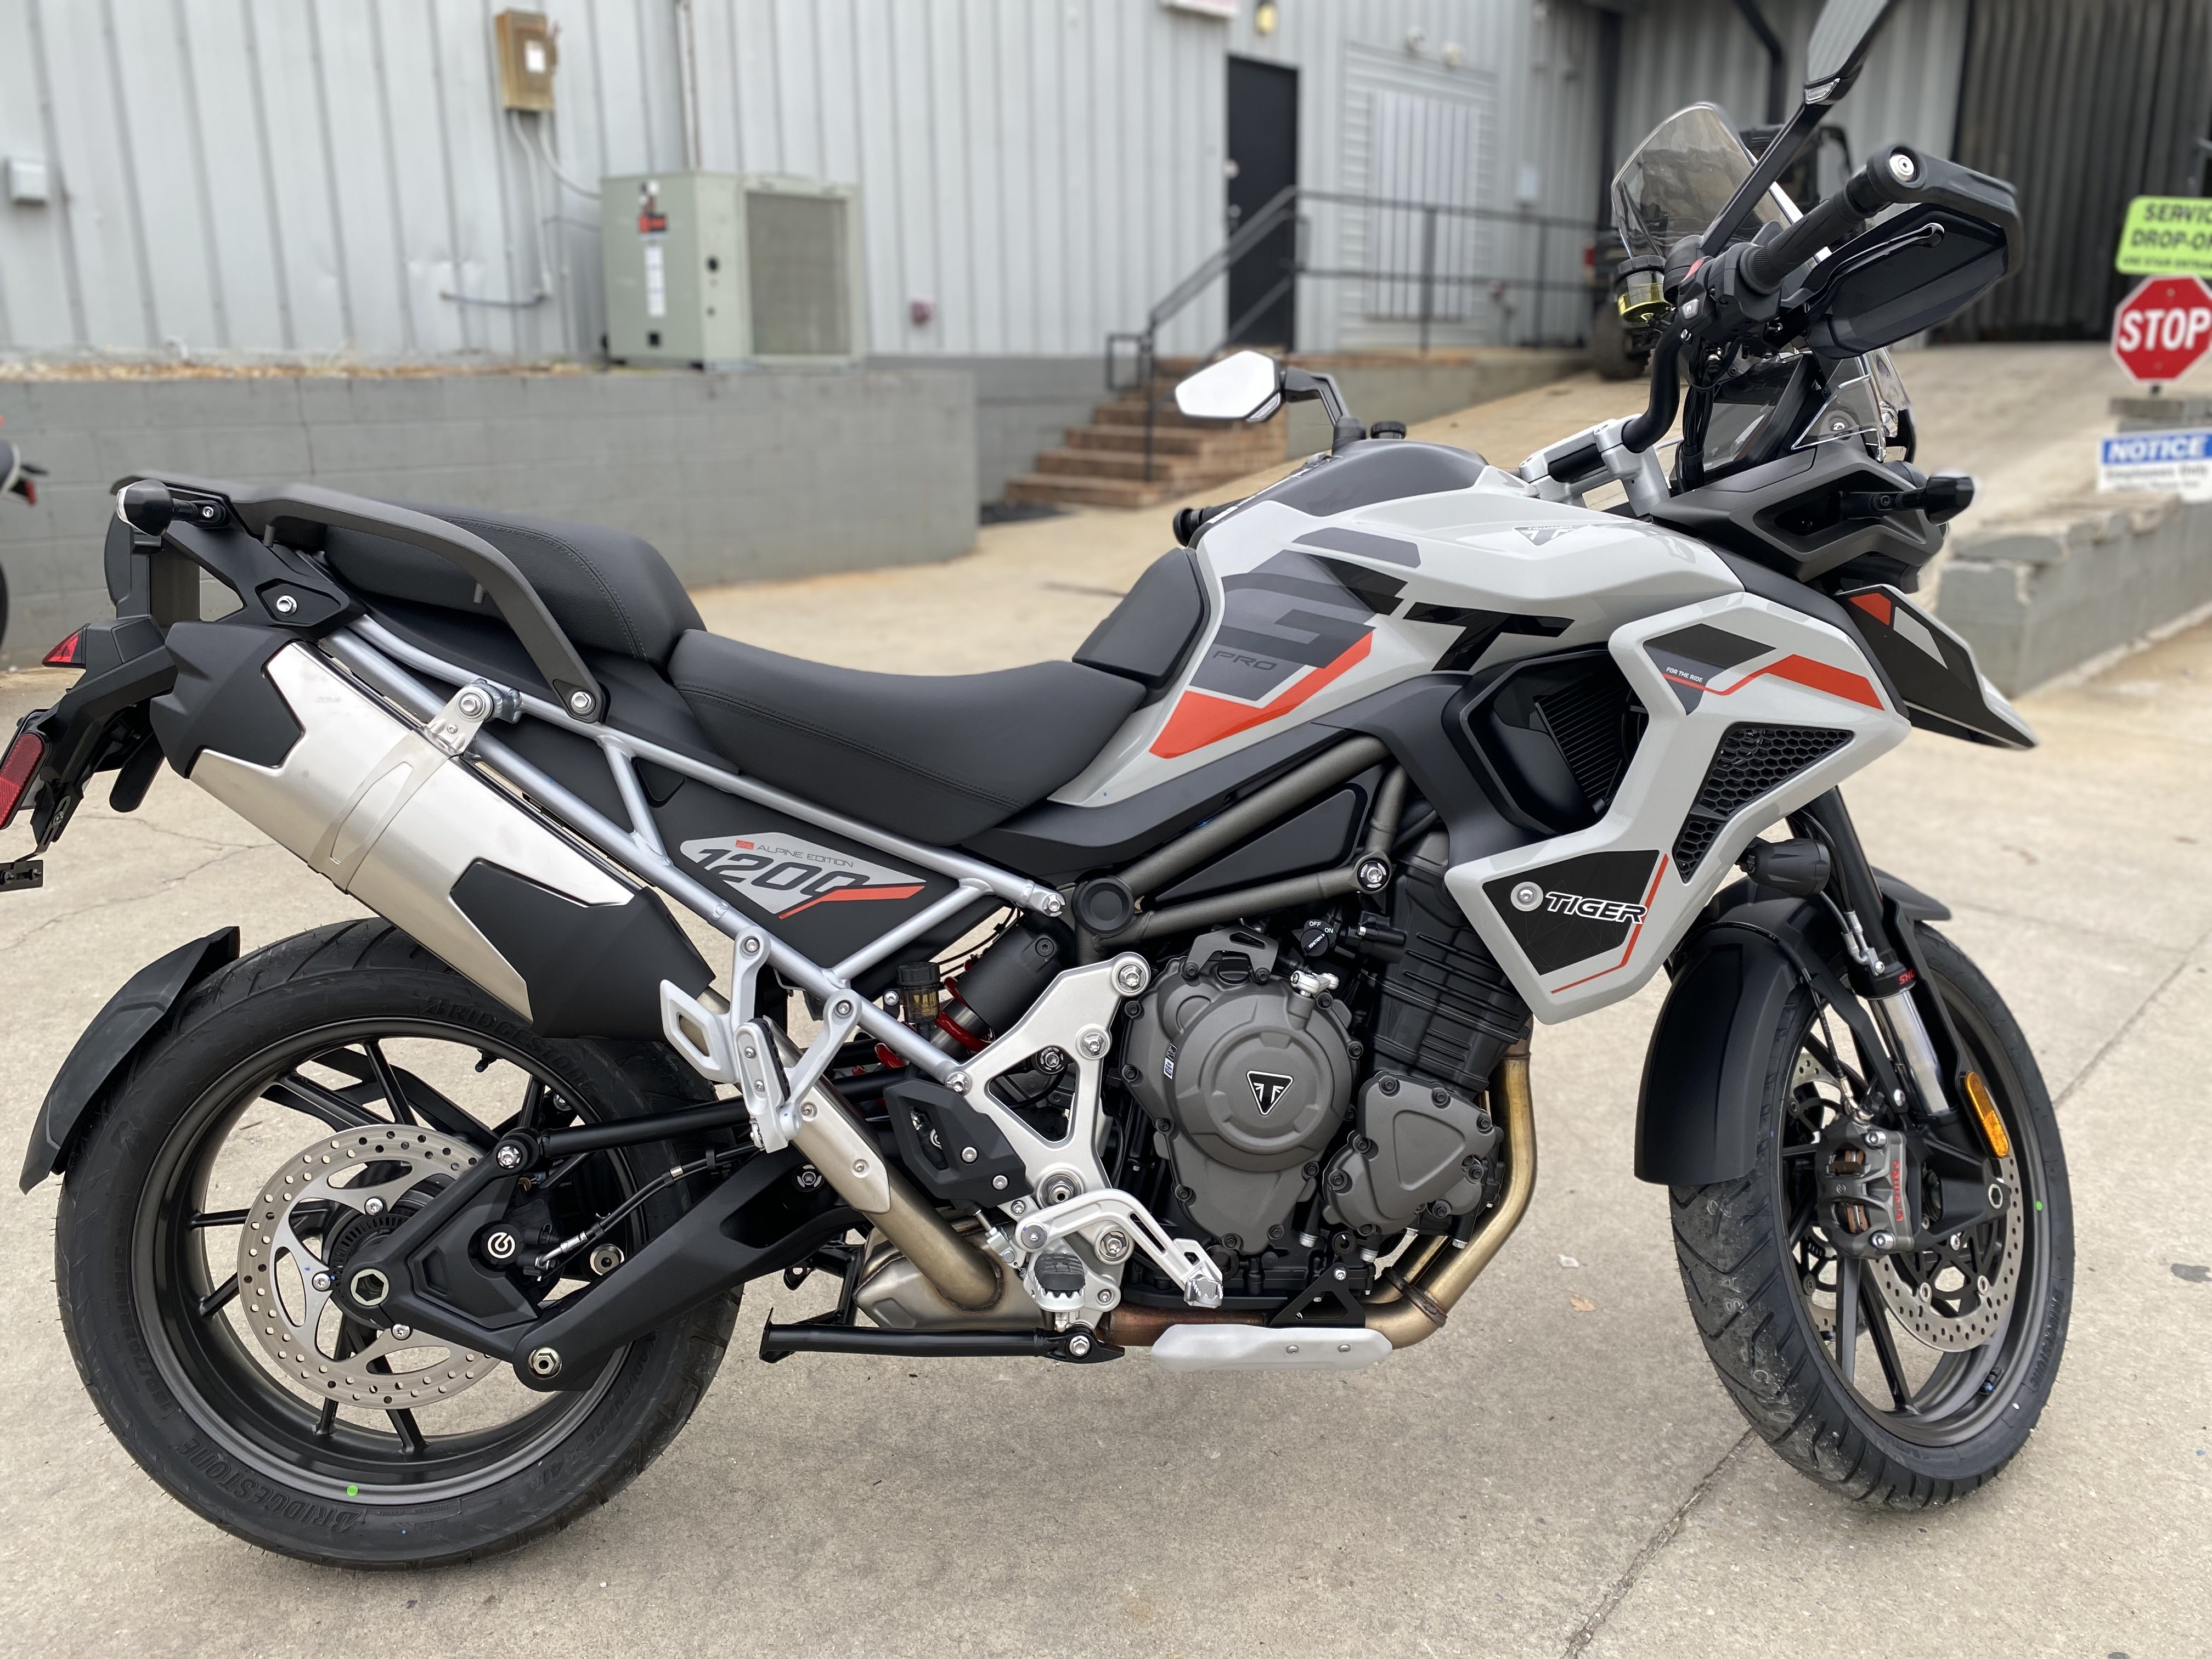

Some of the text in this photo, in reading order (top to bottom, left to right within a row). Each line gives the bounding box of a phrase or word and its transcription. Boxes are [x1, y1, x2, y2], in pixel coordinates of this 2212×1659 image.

[2119, 307, 2212, 352] STOP
[2108, 436, 2207, 462] NOTICE
[1211, 650, 1278, 672] PRO
[1690, 674, 1703, 682] RIDE
[757, 844, 854, 868] ALPINE EDITION
[698, 849, 871, 898] 1200
[1545, 891, 1648, 925] TIGER
[1308, 934, 1323, 949] IGNITION
[420, 995, 600, 1097] BRIDGESTONE
[1890, 1159, 1904, 1222] brembo
[182, 1437, 362, 1535] BRIDGESTONE
